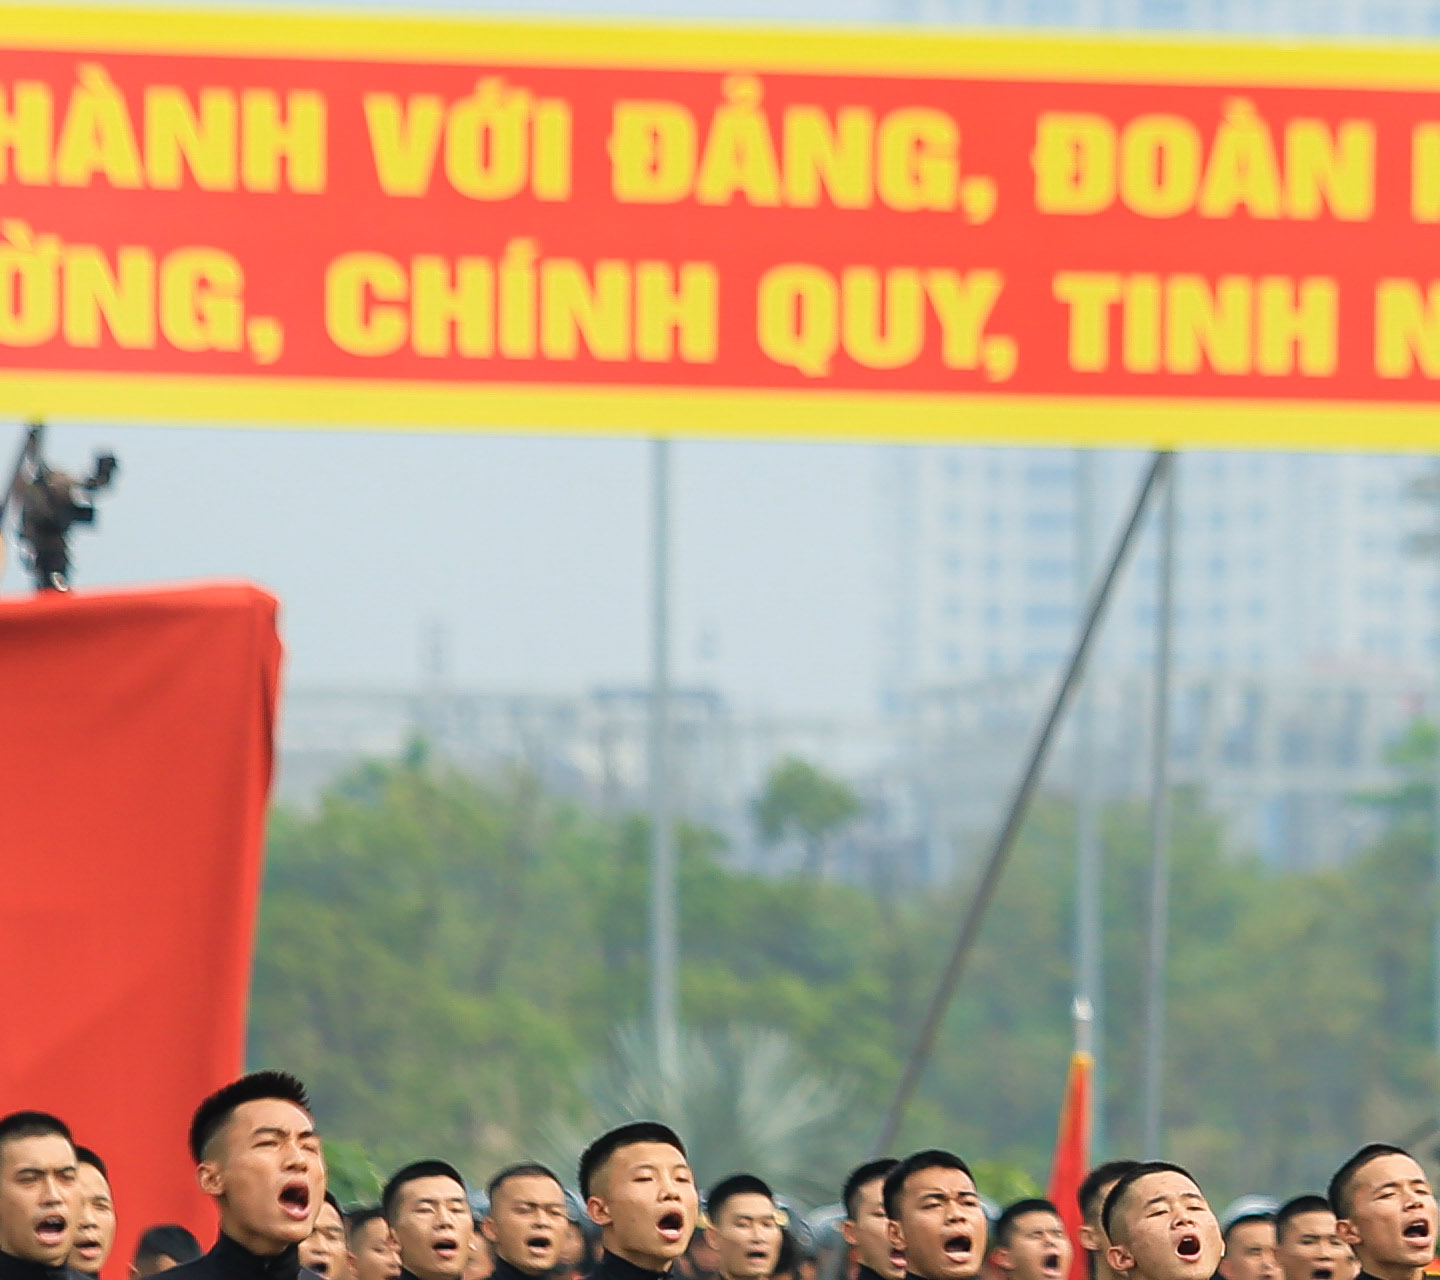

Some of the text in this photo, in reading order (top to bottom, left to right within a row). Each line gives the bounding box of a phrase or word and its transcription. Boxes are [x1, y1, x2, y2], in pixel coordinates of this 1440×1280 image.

[363, 77, 572, 201] VỚI
[610, 72, 997, 223] ĐẢNG,
[1031, 98, 1376, 220] ĐOÀN
[325, 239, 719, 363] CHÍNH
[757, 265, 1017, 382] QUY,
[1053, 272, 1339, 377] TINH
